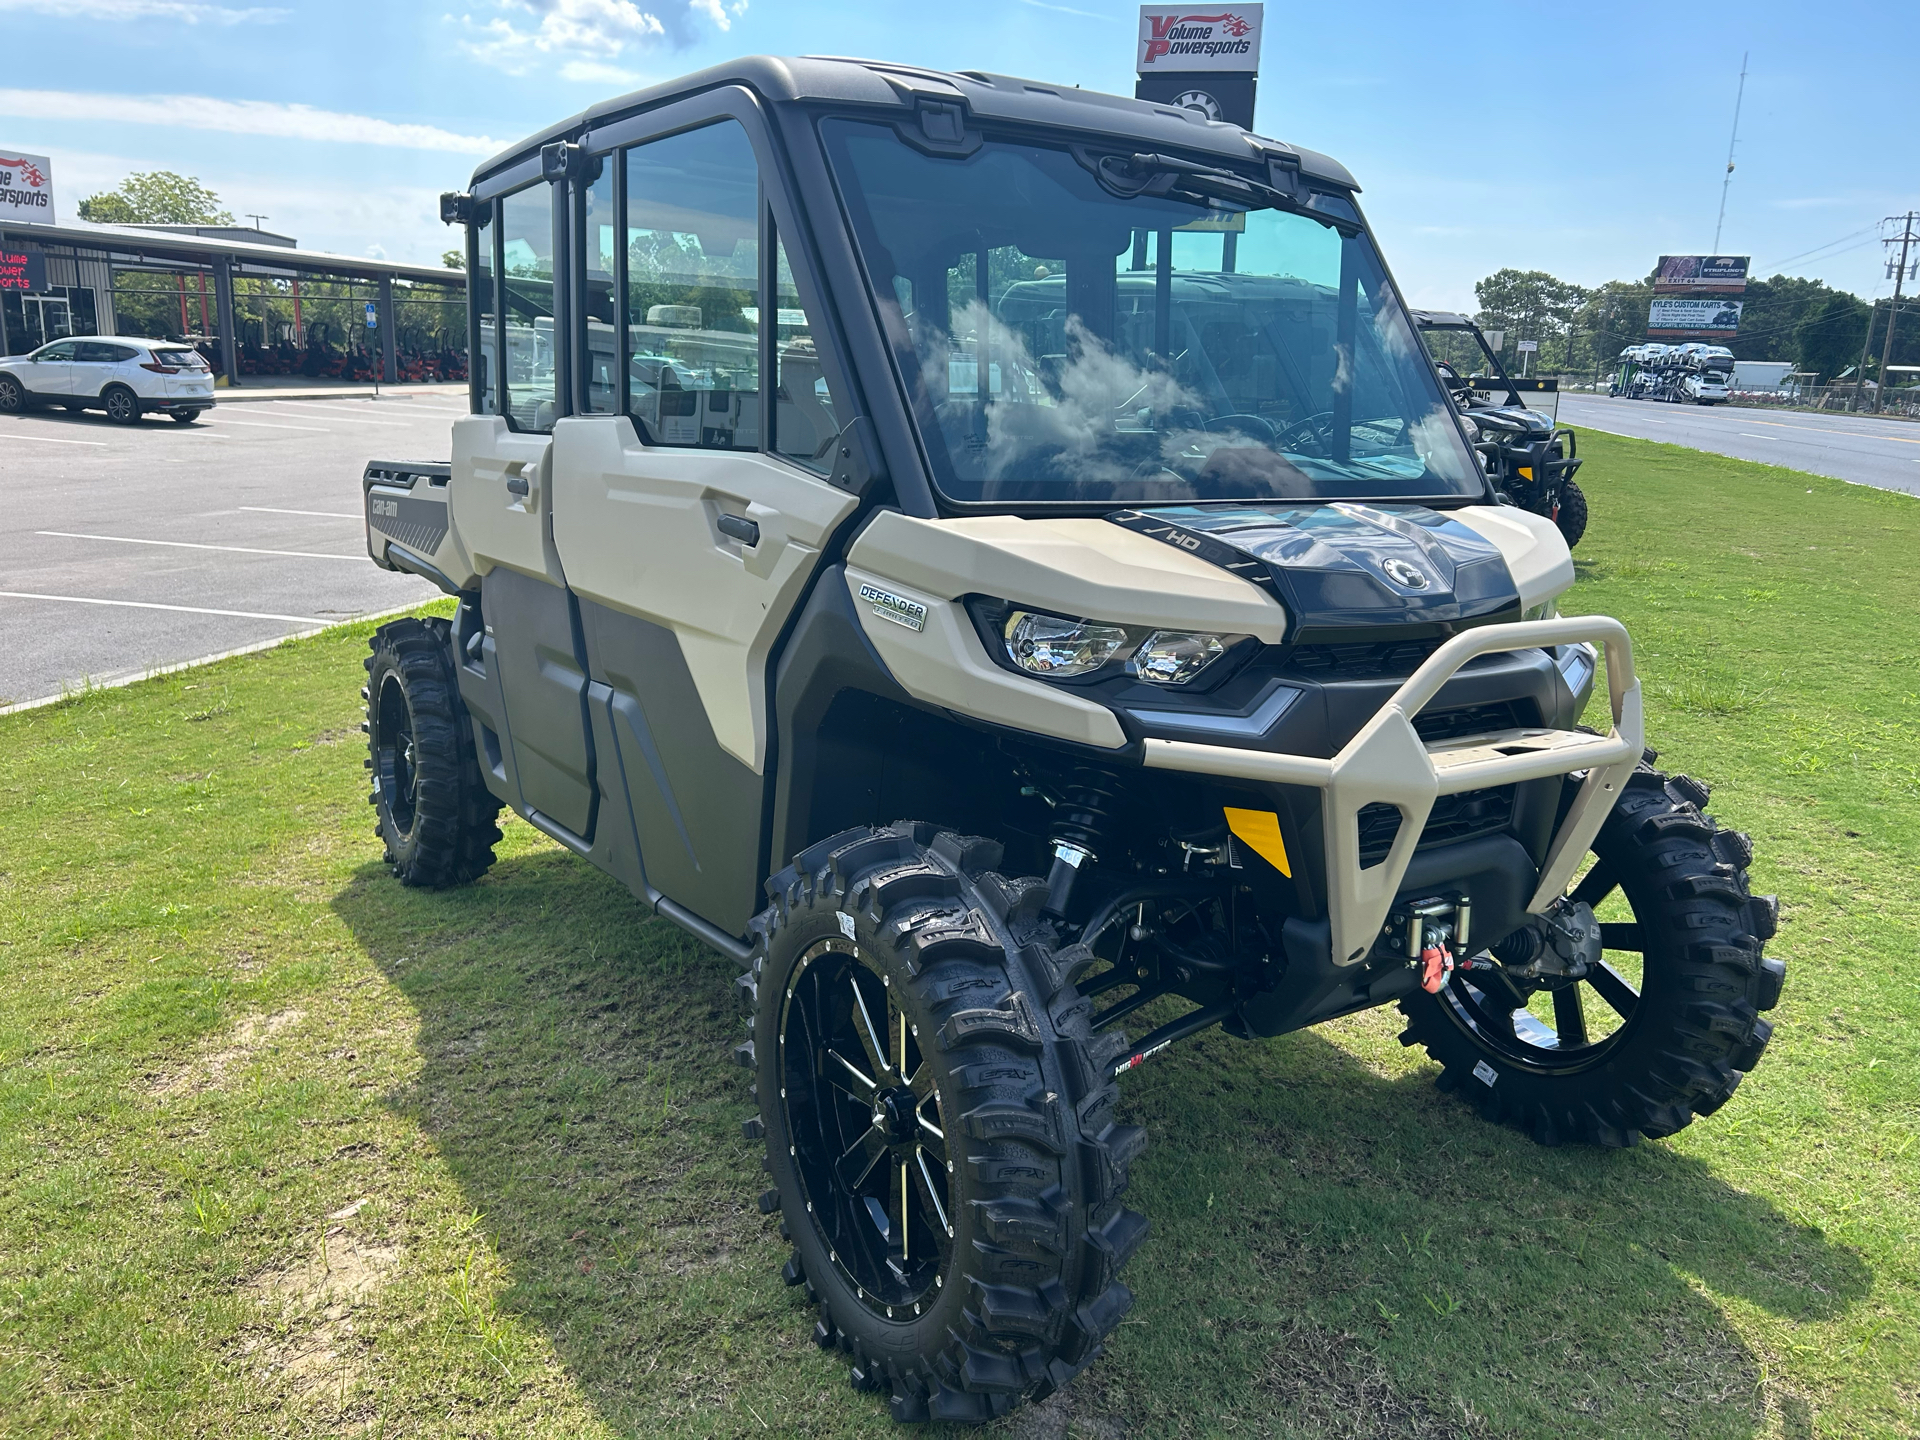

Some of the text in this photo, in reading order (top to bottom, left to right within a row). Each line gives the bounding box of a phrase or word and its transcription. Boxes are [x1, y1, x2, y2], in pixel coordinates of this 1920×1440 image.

[1144, 15, 1213, 40] Volume
[1143, 39, 1251, 63] Powersports
[1674, 301, 1700, 309] CUSTOM
[372, 499, 398, 518] can-am
[860, 585, 924, 617] DEFENDER
